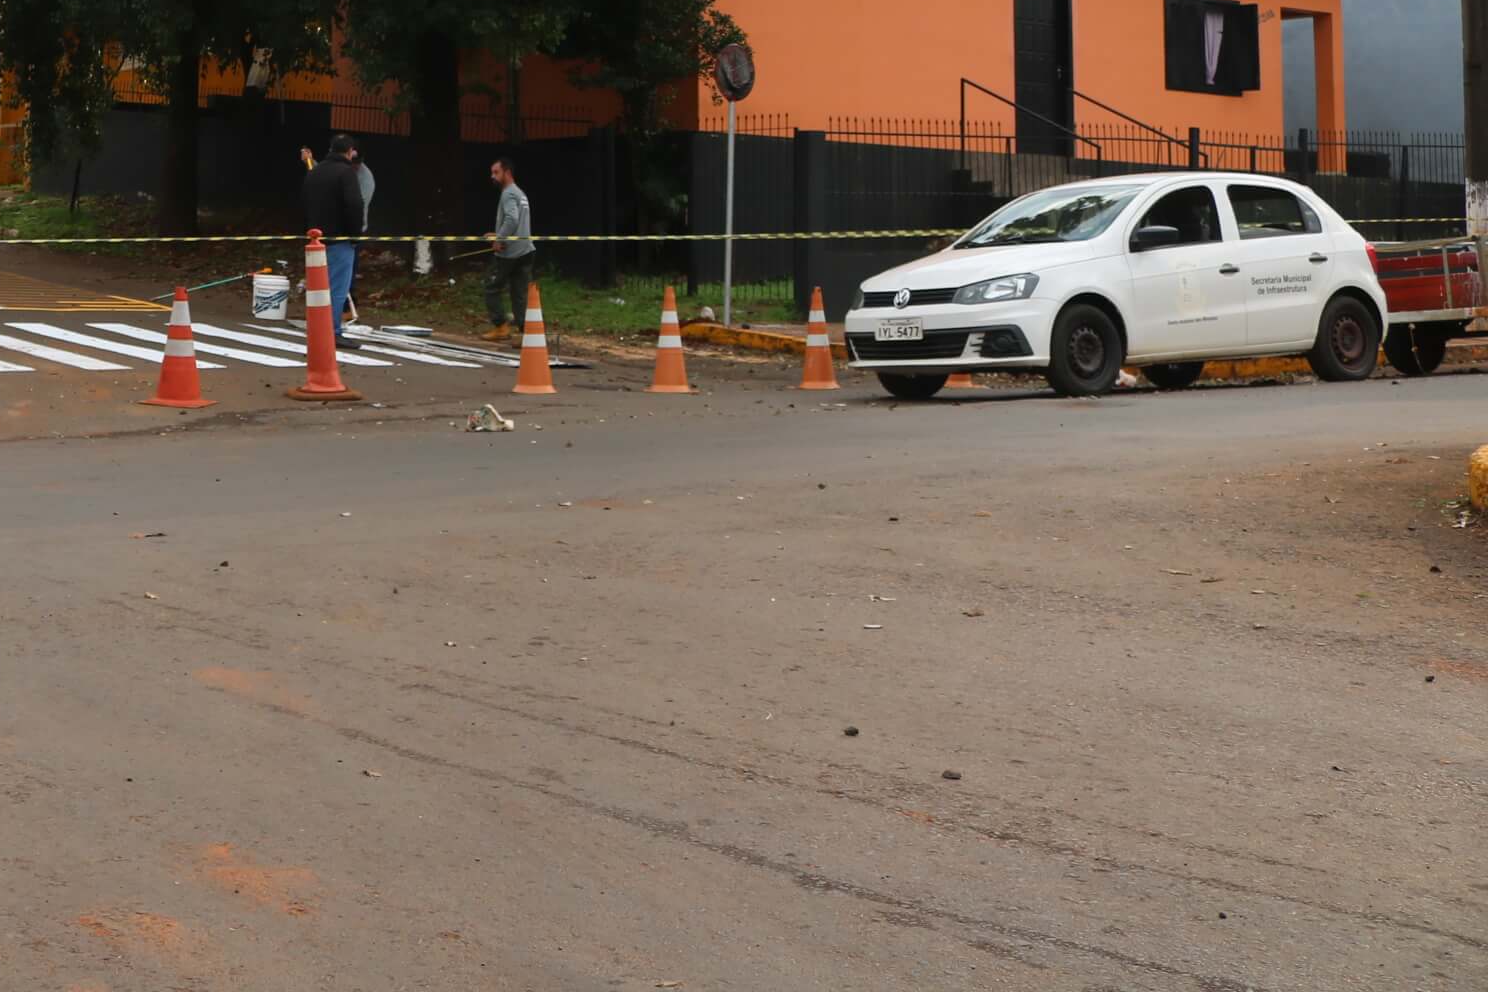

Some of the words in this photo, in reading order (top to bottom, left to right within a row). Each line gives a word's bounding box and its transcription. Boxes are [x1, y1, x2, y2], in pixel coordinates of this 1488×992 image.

[1251, 277, 1282, 285] Secretaria
[1282, 274, 1312, 283] Municipal
[1266, 285, 1307, 294] Infraestrutura
